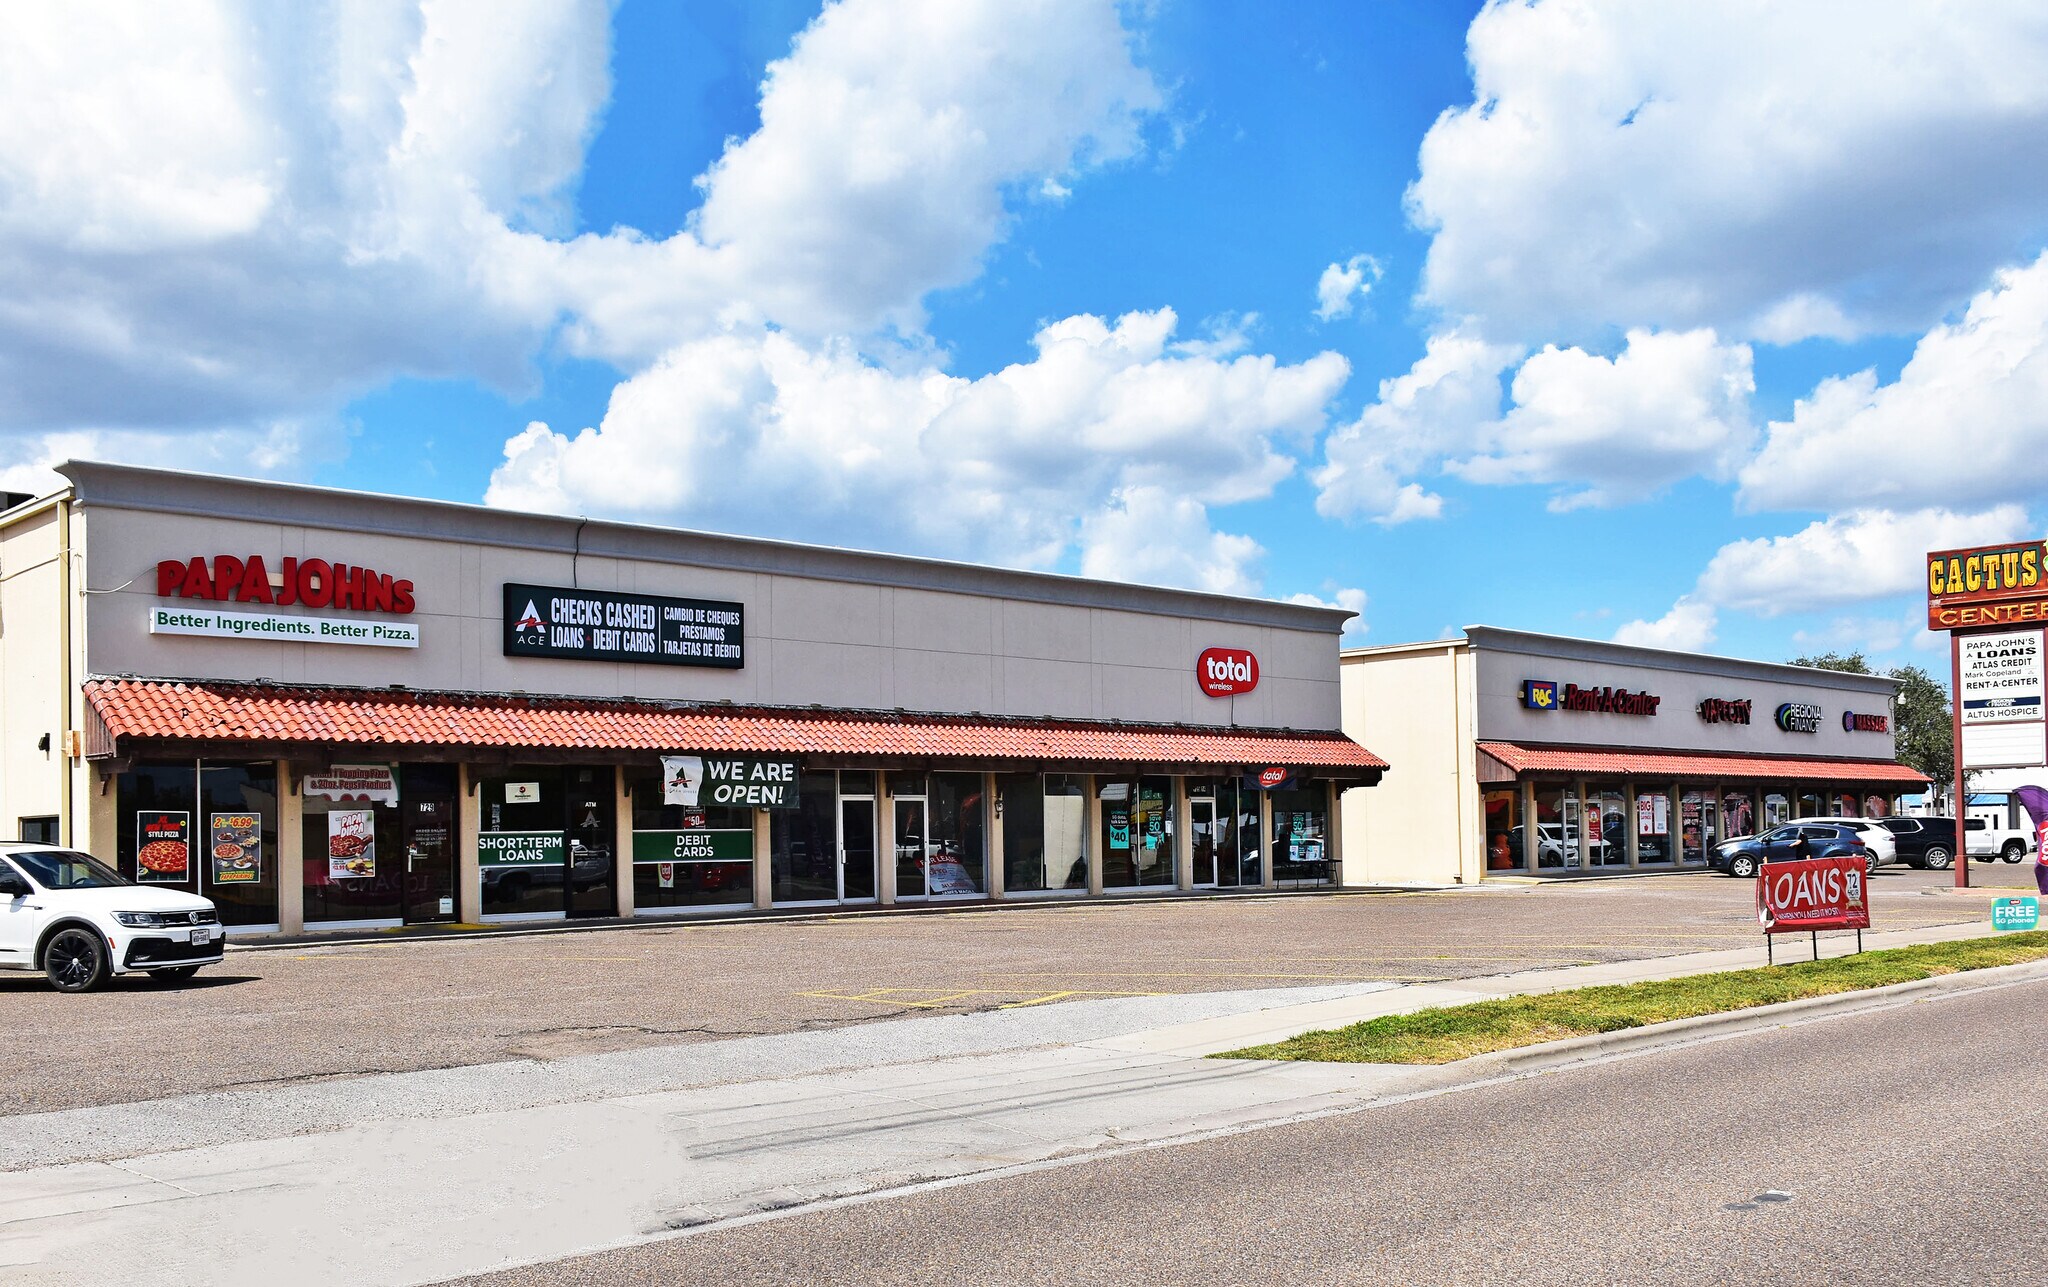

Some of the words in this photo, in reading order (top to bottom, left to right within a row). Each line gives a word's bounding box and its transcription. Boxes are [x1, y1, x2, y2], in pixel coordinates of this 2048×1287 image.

[1930, 550, 2037, 596] CACTUS
[157, 555, 274, 605] PAPA
[275, 557, 416, 614] JOHNS
[551, 597, 601, 627] CHECKS
[605, 602, 656, 630] CASHED
[664, 606, 694, 623] CAMBIO
[695, 609, 705, 623] DE
[706, 610, 740, 626] CHEQUES
[157, 612, 211, 628] Better
[216, 615, 315, 636] Ingredients.
[320, 622, 368, 638] Better
[372, 626, 415, 641] Pizza.
[679, 624, 725, 641] PRÉSTAMOS
[517, 635, 545, 646] ACE
[551, 625, 585, 649] LOANS
[593, 629, 620, 651] DEBIT
[623, 631, 656, 653] CARDS
[1966, 641, 1993, 650] PAPA
[1995, 637, 2036, 648] JOHN'S
[663, 639, 702, 657] TARJETAS
[702, 644, 713, 657] DE
[714, 642, 741, 659] DÉBITO
[1977, 647, 2037, 659] LOANS
[1206, 655, 1252, 682] total
[1972, 660, 1999, 670] ATLAS
[2001, 658, 2032, 668] CREDIT
[1965, 671, 1984, 679] Mark
[1986, 668, 2022, 678] Copeland
[1208, 681, 1233, 691] wireless
[1532, 688, 1553, 707] RAC
[1790, 703, 1824, 719] REGIONAL
[1966, 710, 1995, 719] ALTUS
[1997, 707, 2038, 717] HOSPICE
[1790, 717, 1821, 733] FINANCE
[1855, 714, 1888, 733] MASSAGE
[708, 760, 744, 781] WE
[750, 762, 794, 782] ARE
[713, 784, 784, 805] OPEN!
[420, 803, 434, 812] 729
[1641, 801, 1651, 811] BIG
[213, 816, 222, 829] 2
[341, 812, 362, 827] PAPA
[148, 830, 163, 838] STYLE
[340, 822, 364, 838] DIPPA
[1111, 831, 1126, 842] $40
[478, 836, 562, 849] SHORT-TERM
[676, 835, 711, 846] DEBIT
[499, 849, 544, 861] LOANS
[673, 846, 714, 857] CARDS
[920, 857, 936, 866] FR
[1847, 872, 1858, 890] 72
[1995, 905, 2036, 918] FREE
[2007, 917, 2036, 925] phones
